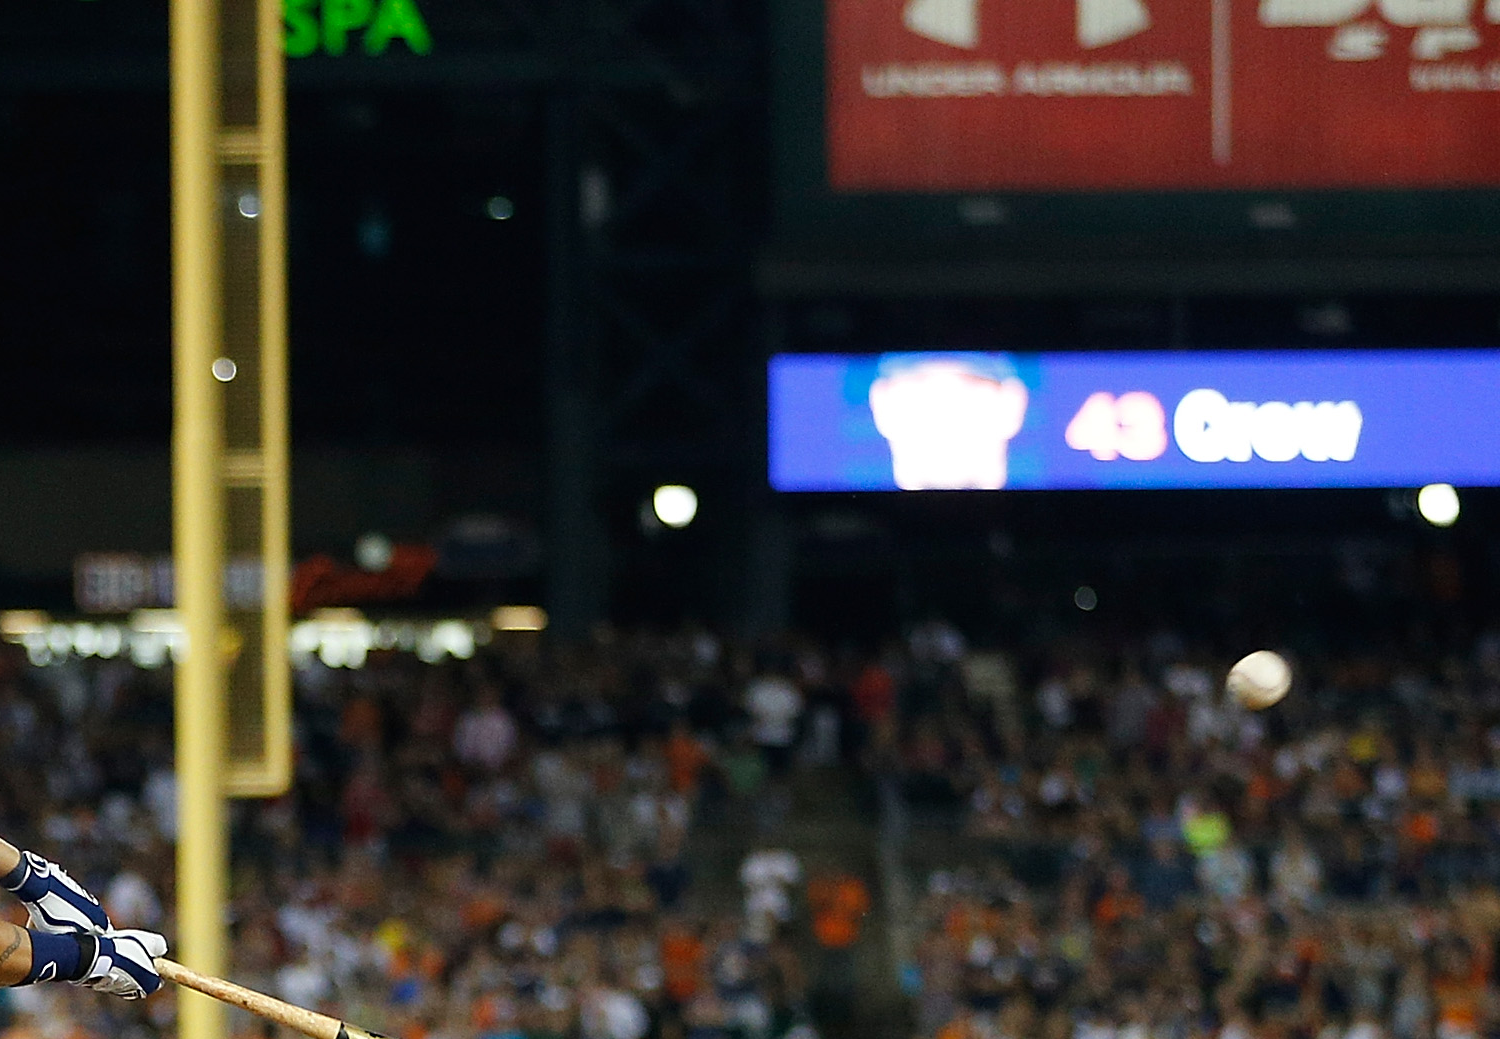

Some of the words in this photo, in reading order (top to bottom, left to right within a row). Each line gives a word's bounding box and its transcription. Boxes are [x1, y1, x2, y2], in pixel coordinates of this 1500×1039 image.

[284, 0, 432, 58] SPA
[1065, 390, 1168, 461] 43
[1174, 388, 1363, 462] Crow
